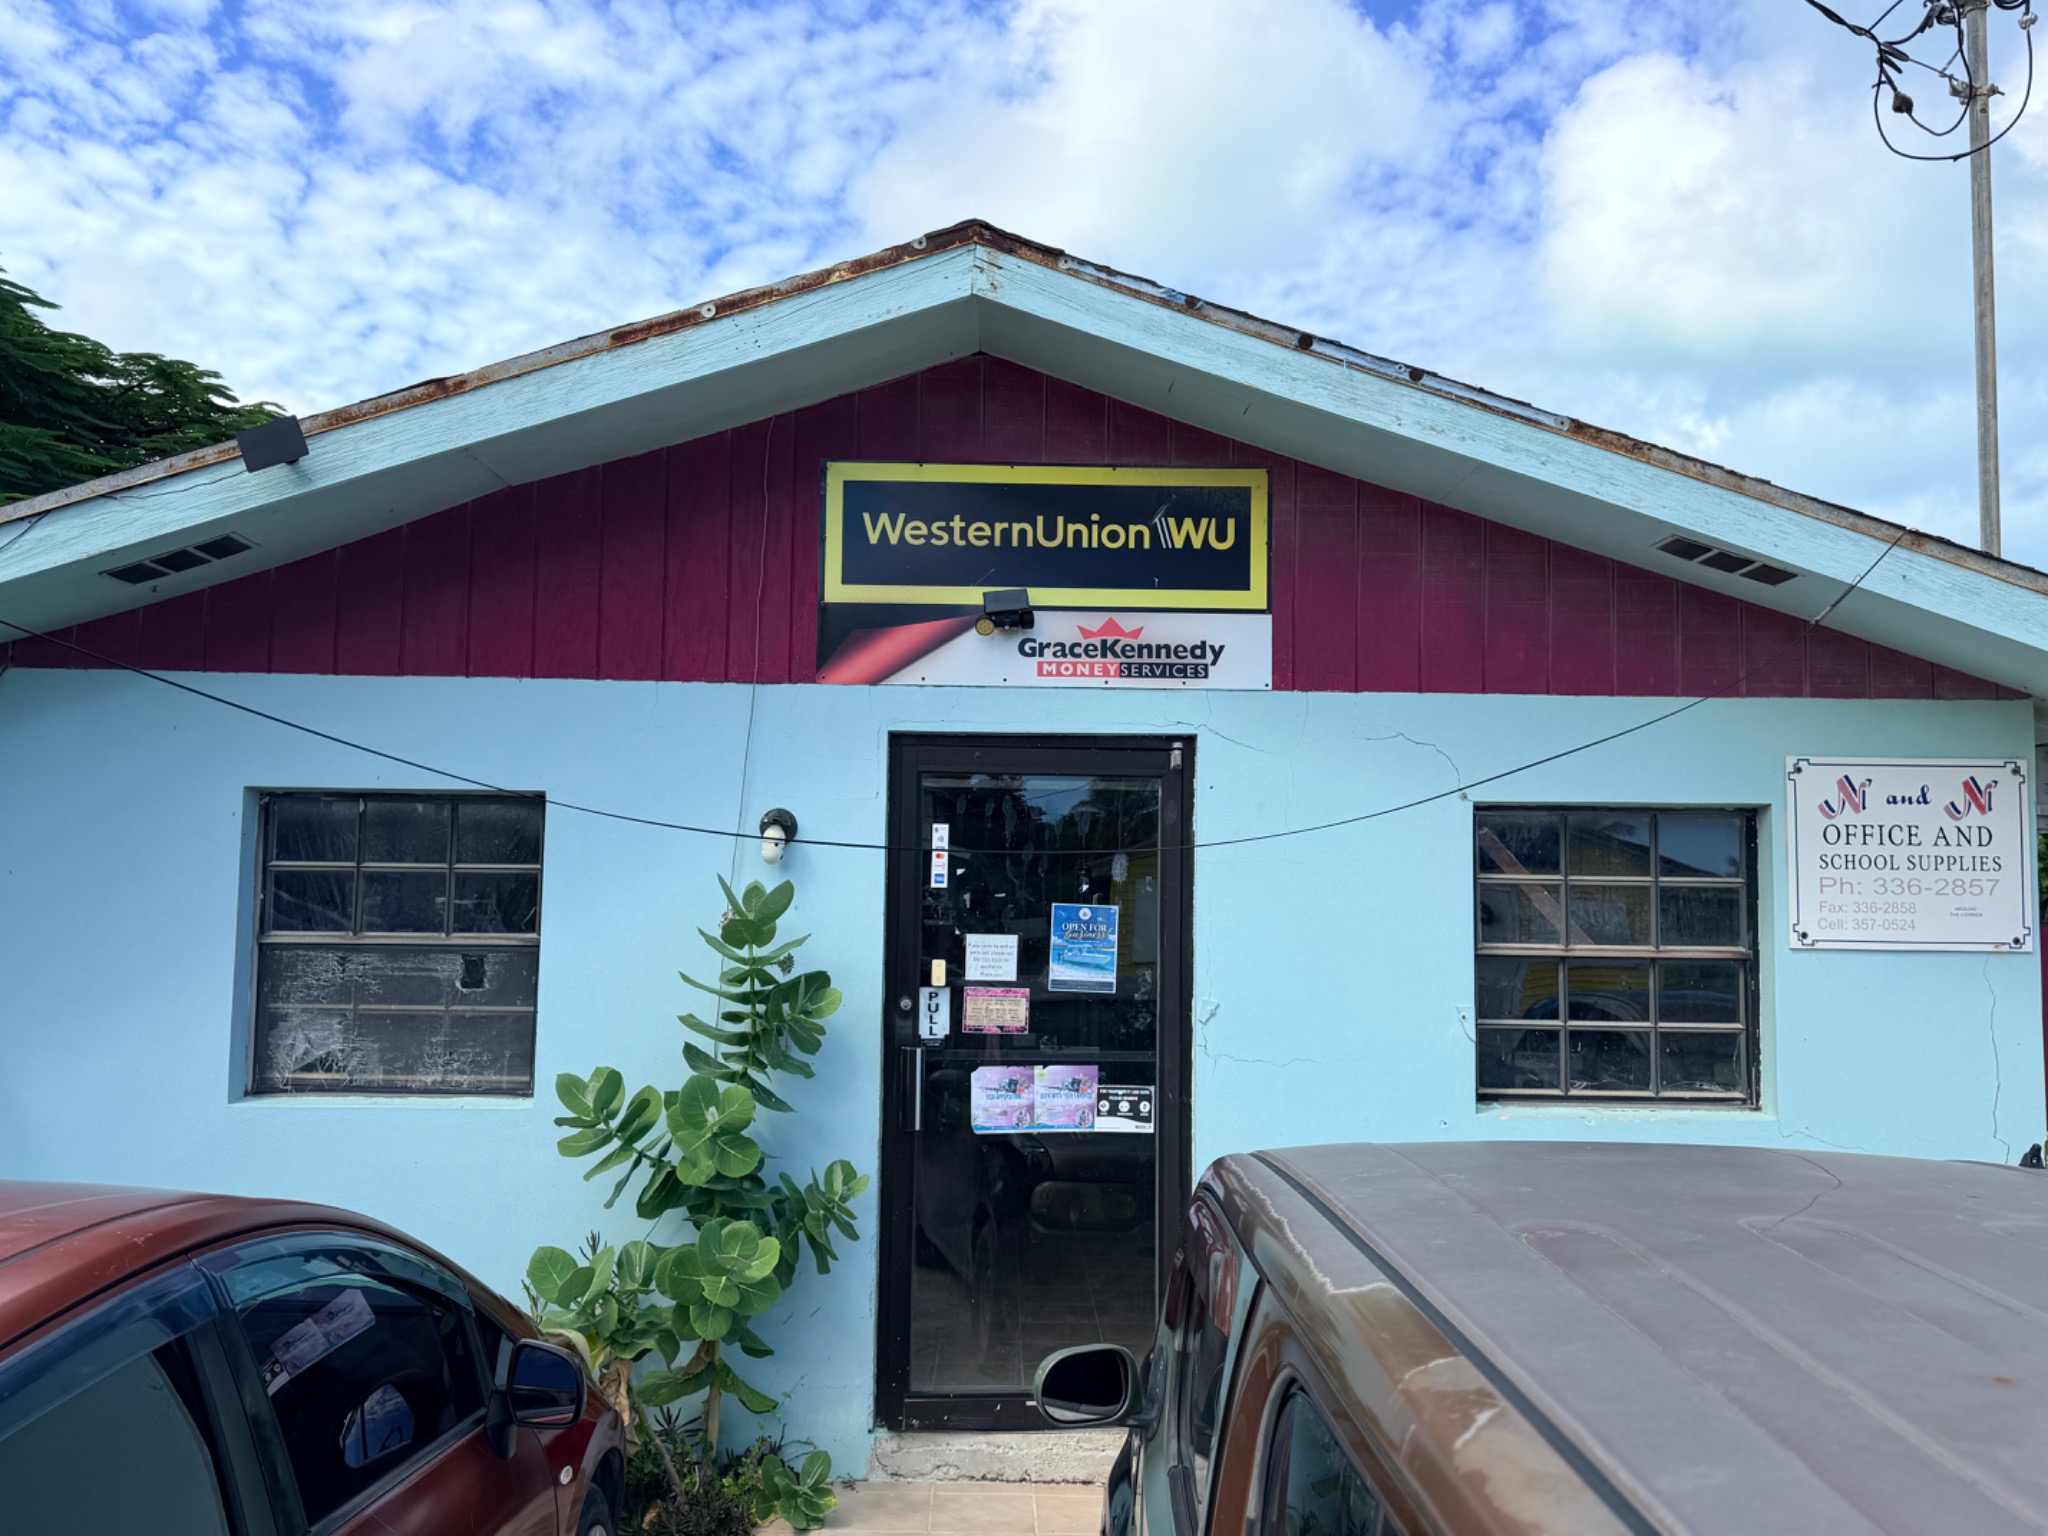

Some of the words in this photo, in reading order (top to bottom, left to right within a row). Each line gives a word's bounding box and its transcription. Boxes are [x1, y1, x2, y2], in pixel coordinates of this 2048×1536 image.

[862, 512, 1150, 550] WesternUnion
[1168, 516, 1236, 550] WU
[1017, 637, 1225, 666] GraceKennedy
[1041, 662, 1118, 677] MONEY
[1121, 663, 1206, 678] SERVICES
[1886, 784, 1932, 806] and
[1822, 823, 1923, 847] OFFICE
[1933, 825, 1993, 847] AND
[1819, 854, 1900, 871] SCHOOL
[1906, 855, 2002, 872] SUPPLIES
[1819, 877, 1863, 896] Ph:
[1873, 877, 2000, 896] 336-2857
[1819, 901, 1848, 914] Fax:
[1852, 901, 1917, 914] 336-2858
[1062, 921, 1087, 931] OPEN
[1089, 923, 1107, 932] FOR
[1817, 918, 1848, 931] Cell:
[1852, 918, 1916, 931] 357-0524
[927, 991, 939, 1037] PULL
